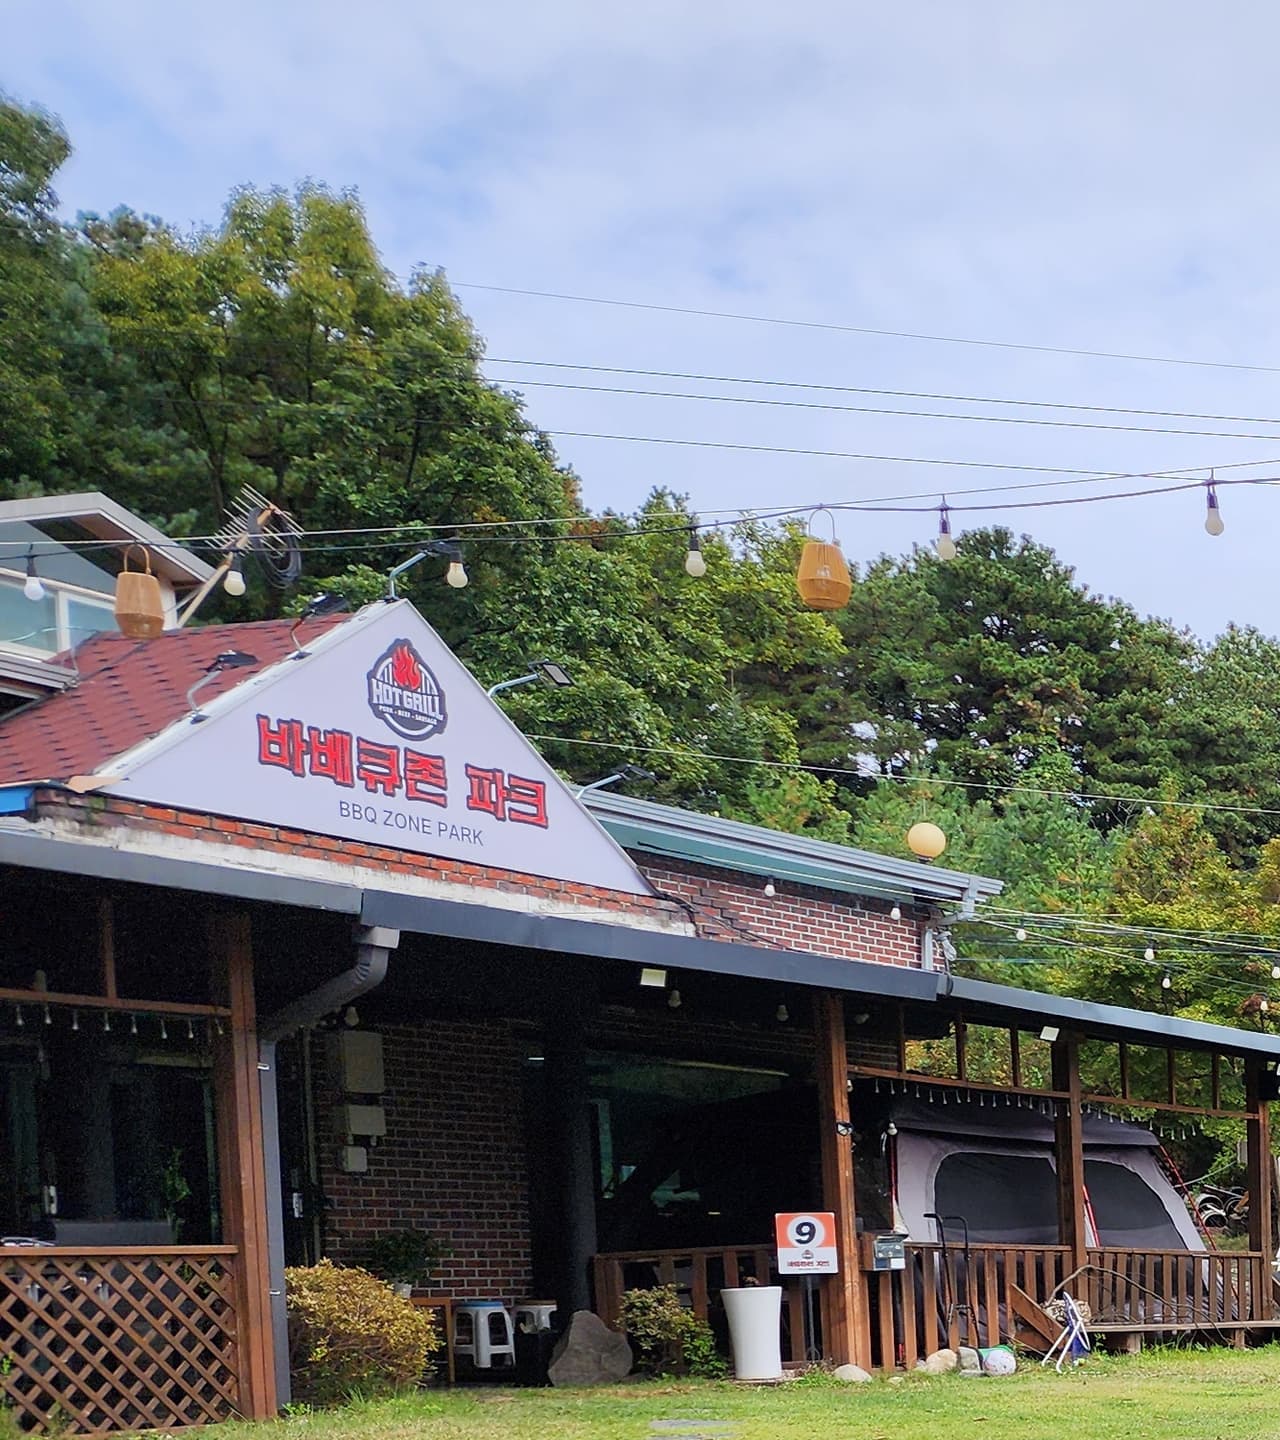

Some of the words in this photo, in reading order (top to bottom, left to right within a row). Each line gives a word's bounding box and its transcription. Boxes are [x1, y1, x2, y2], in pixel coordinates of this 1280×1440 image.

[371, 678, 402, 707] HOT
[402, 690, 444, 721] GRILL
[256, 714, 448, 808] 바베큐존
[464, 763, 549, 829] 파크
[339, 801, 377, 824] BBQ
[383, 810, 432, 835] ZONE
[438, 822, 484, 846] PARK
[795, 1221, 817, 1245] 9
